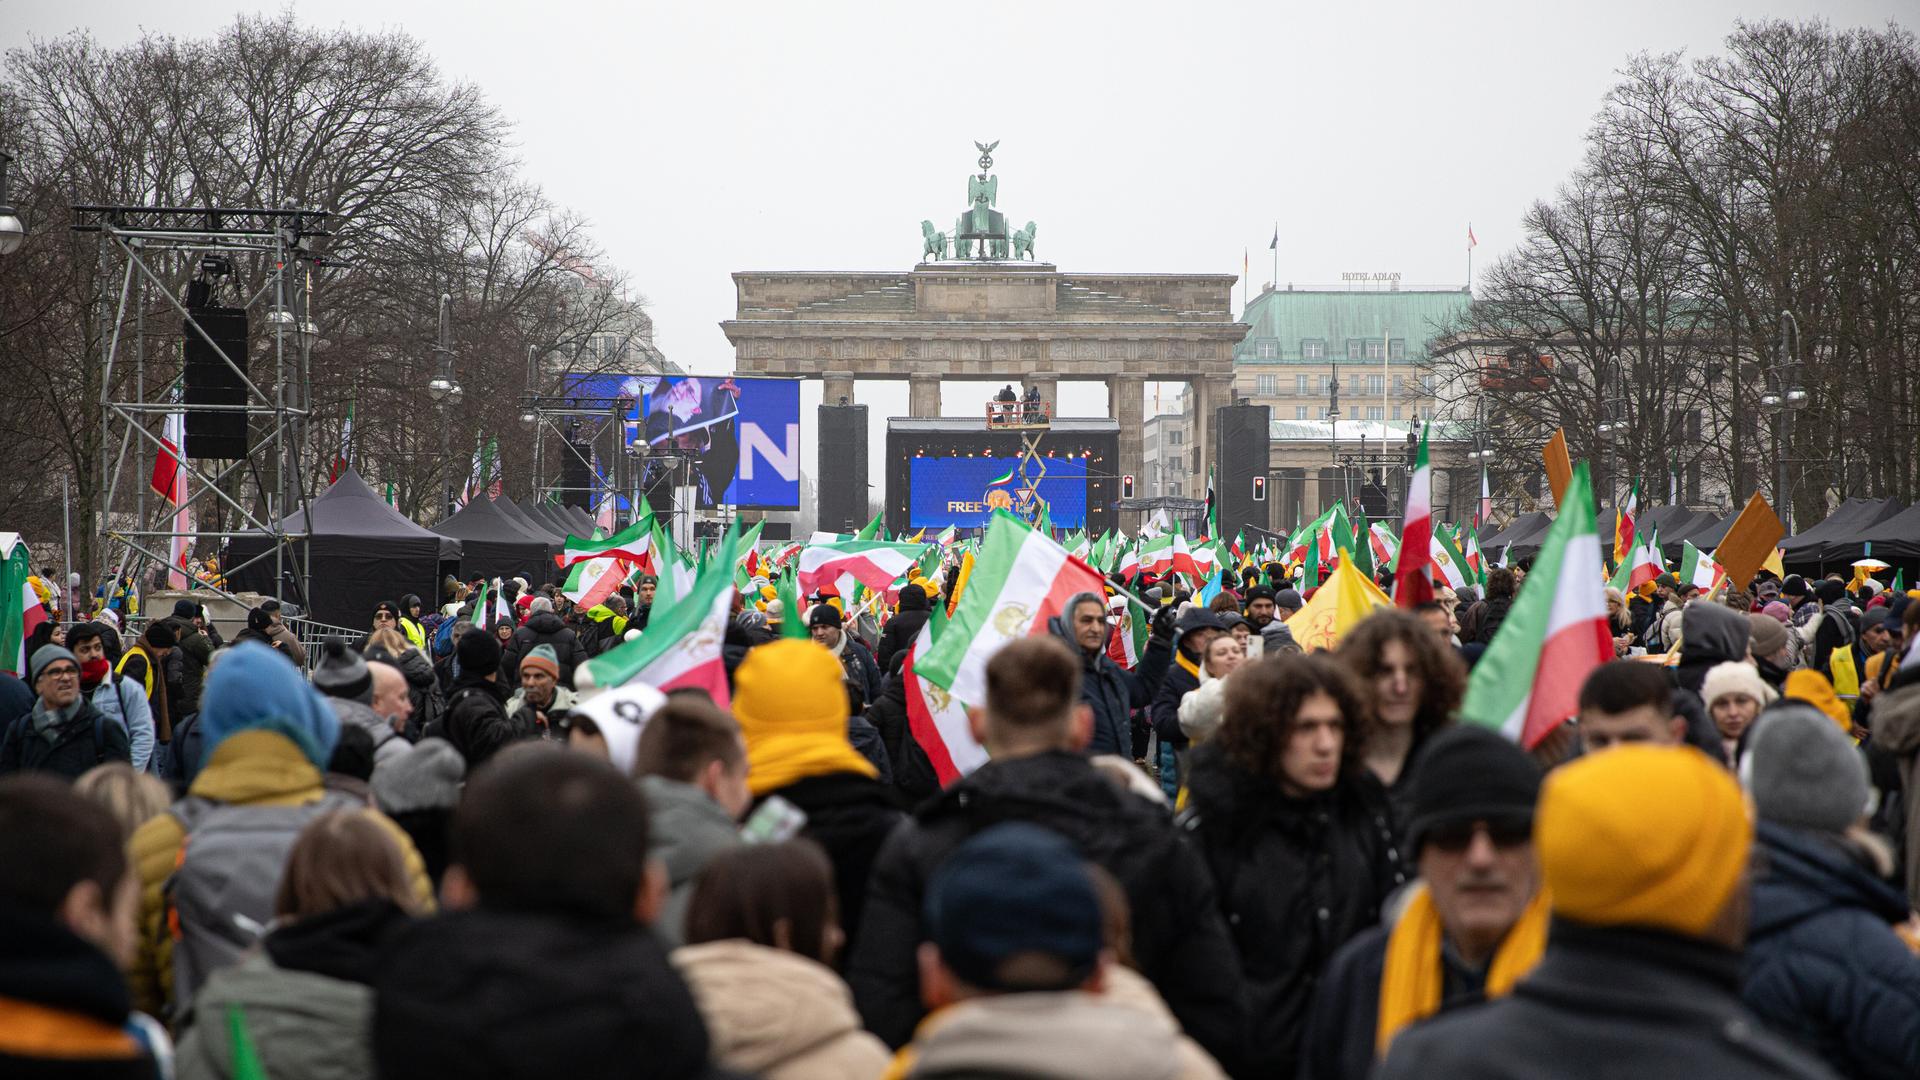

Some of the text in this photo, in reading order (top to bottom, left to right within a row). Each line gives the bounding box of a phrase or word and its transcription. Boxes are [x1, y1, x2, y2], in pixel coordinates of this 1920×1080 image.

[1342, 272, 1401, 281] HOTEL ADLON
[947, 501, 983, 513] FREE
